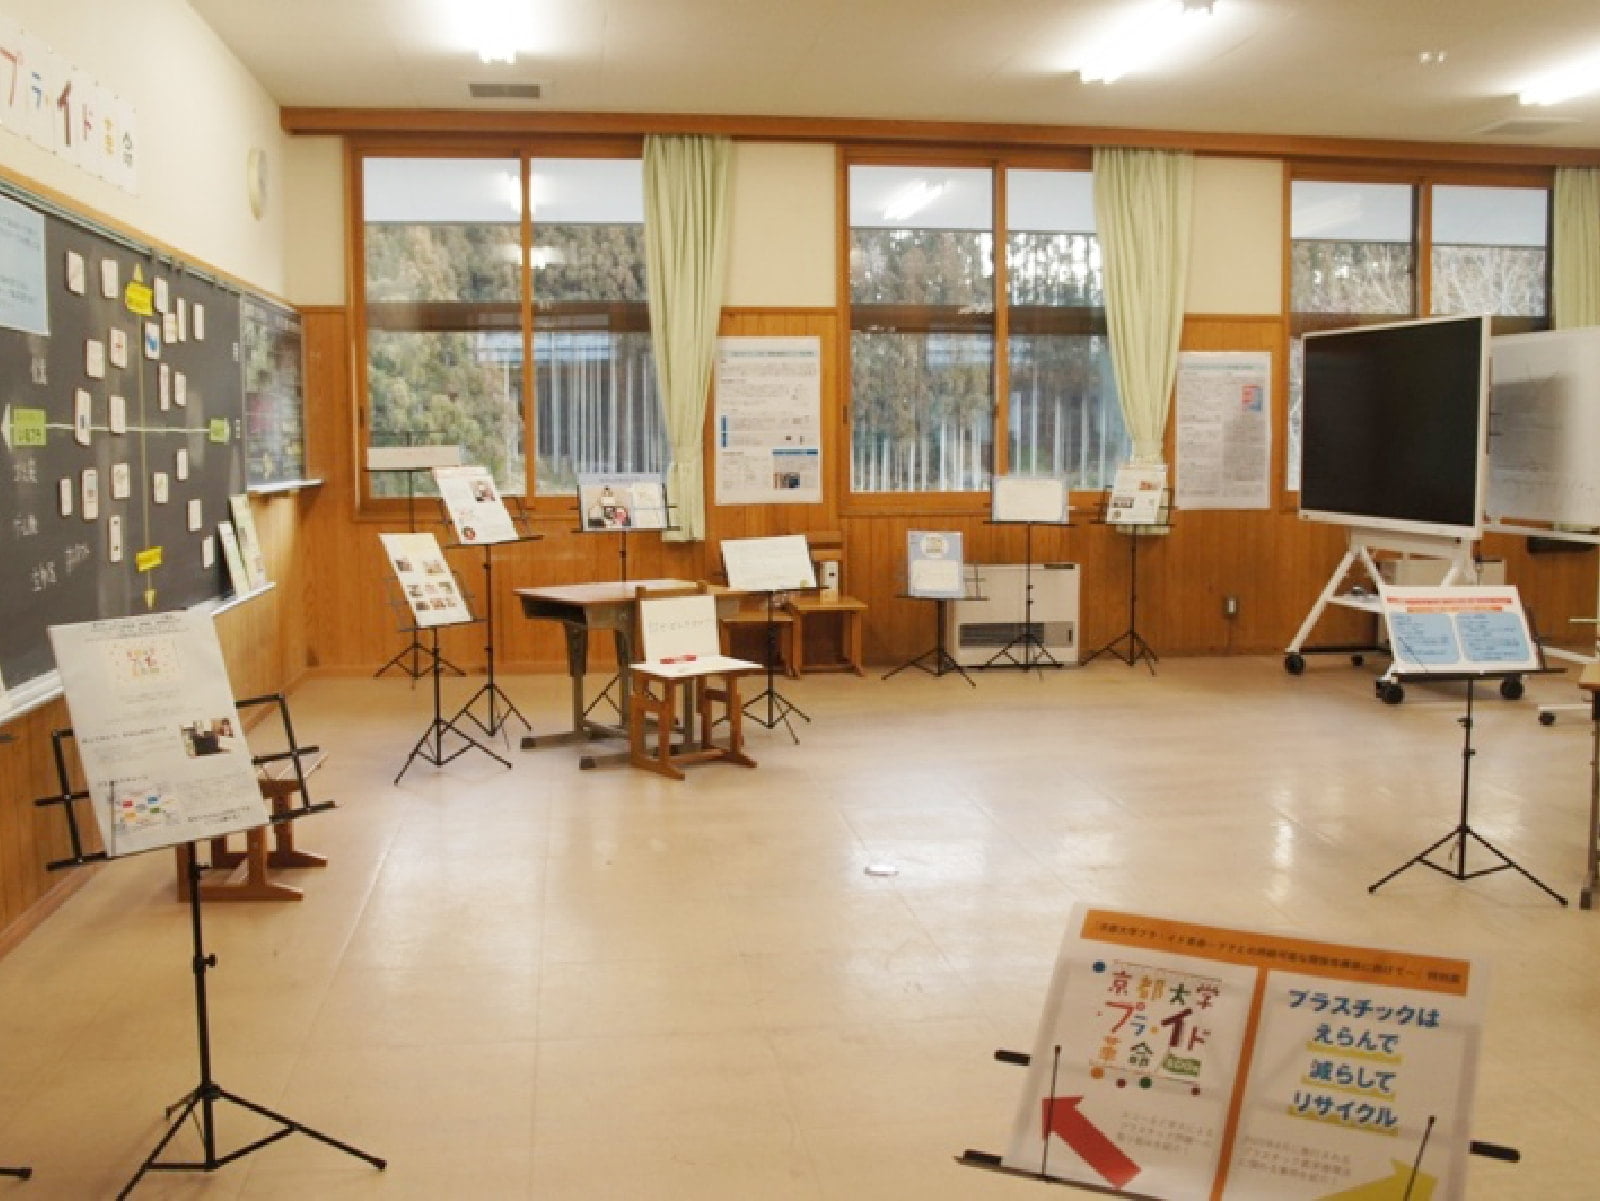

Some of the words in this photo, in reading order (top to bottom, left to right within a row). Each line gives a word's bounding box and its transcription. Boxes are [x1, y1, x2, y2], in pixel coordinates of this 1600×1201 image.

[1107, 970, 1220, 1010] 京都大学
[1289, 989, 1440, 1027] プラスチックは
[1313, 1022, 1399, 1054] えらんで
[1309, 1058, 1397, 1093] 減らして
[1293, 1090, 1399, 1127] リサイクル
